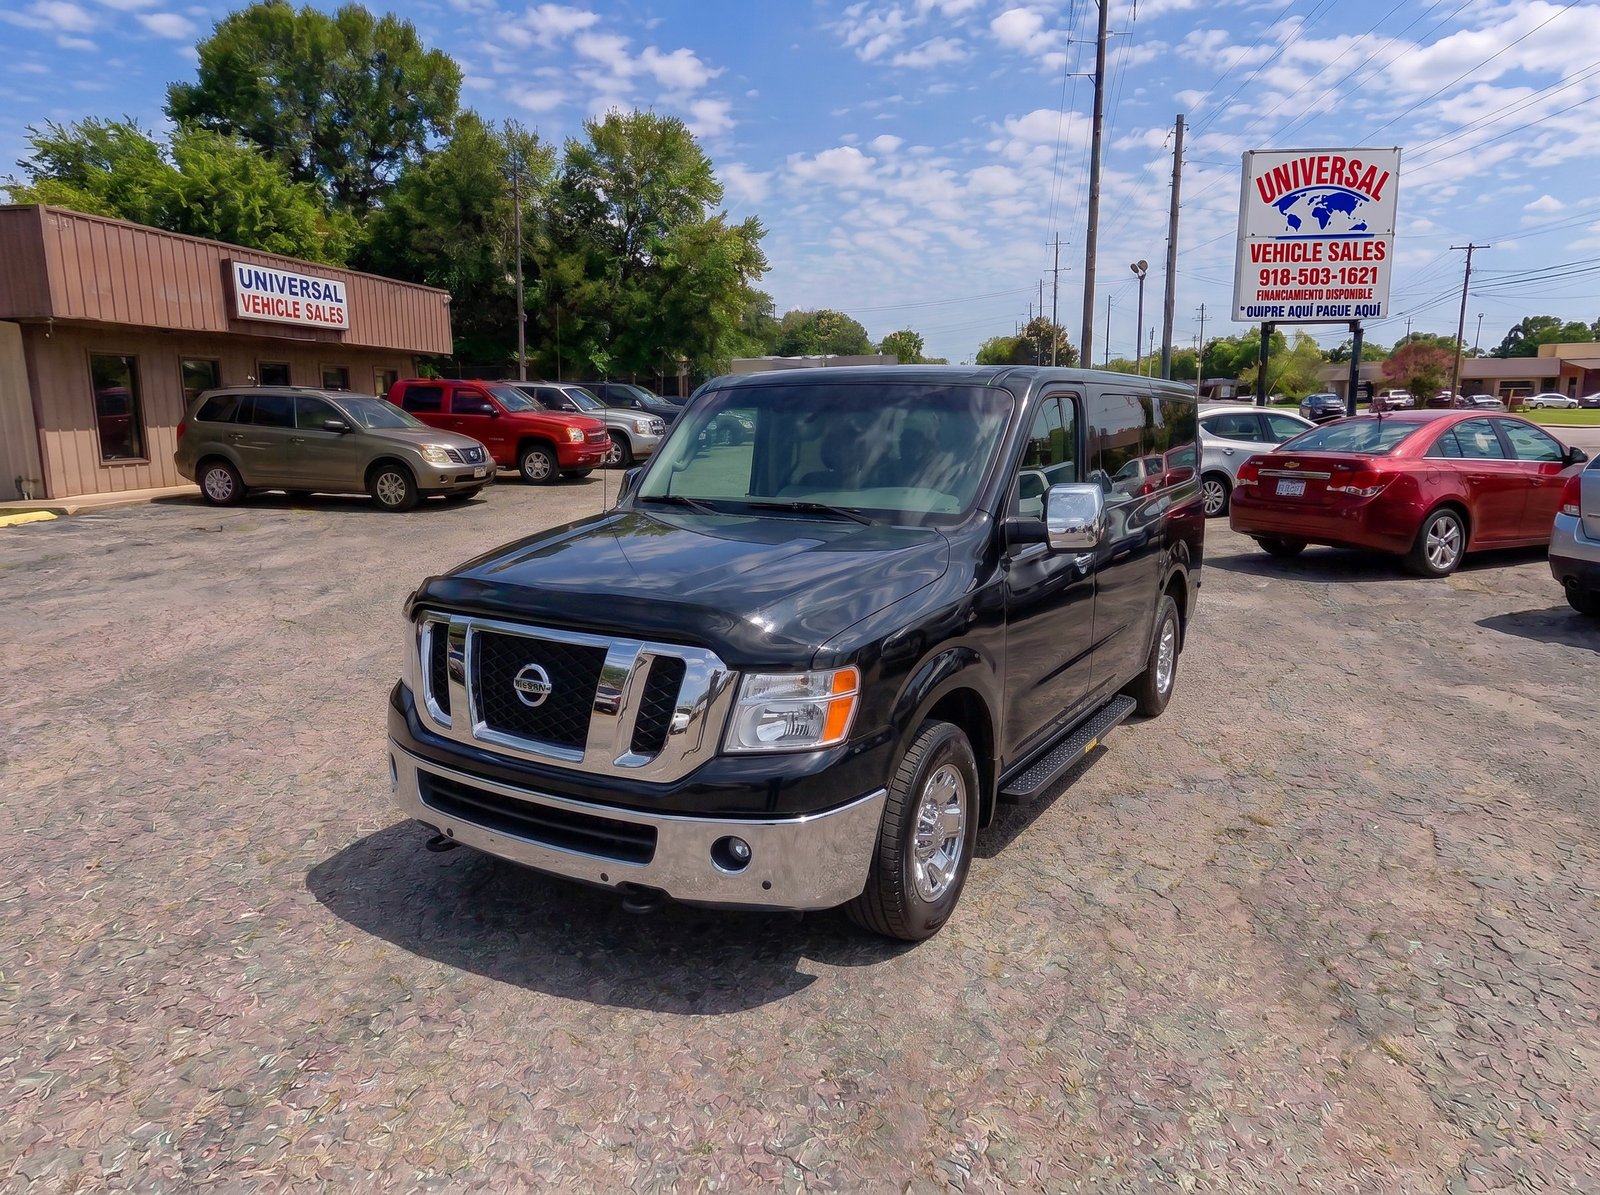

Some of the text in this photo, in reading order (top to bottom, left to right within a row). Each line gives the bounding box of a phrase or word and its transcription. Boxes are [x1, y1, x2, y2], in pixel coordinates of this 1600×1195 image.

[1256, 156, 1390, 203] UNIVERSAL
[1251, 241, 1386, 263] VEHICLE SALES
[238, 267, 343, 303] UNIVERSAL
[1259, 267, 1378, 286] 918-503-1621
[1256, 288, 1373, 301] FINANCIAMIENTO DISPONIBLE
[241, 293, 344, 324] VEHICLE SALES
[1288, 303, 1314, 318] AQUÍ
[1316, 305, 1351, 317] PAGUE
[1354, 302, 1381, 318] AQUÍ
